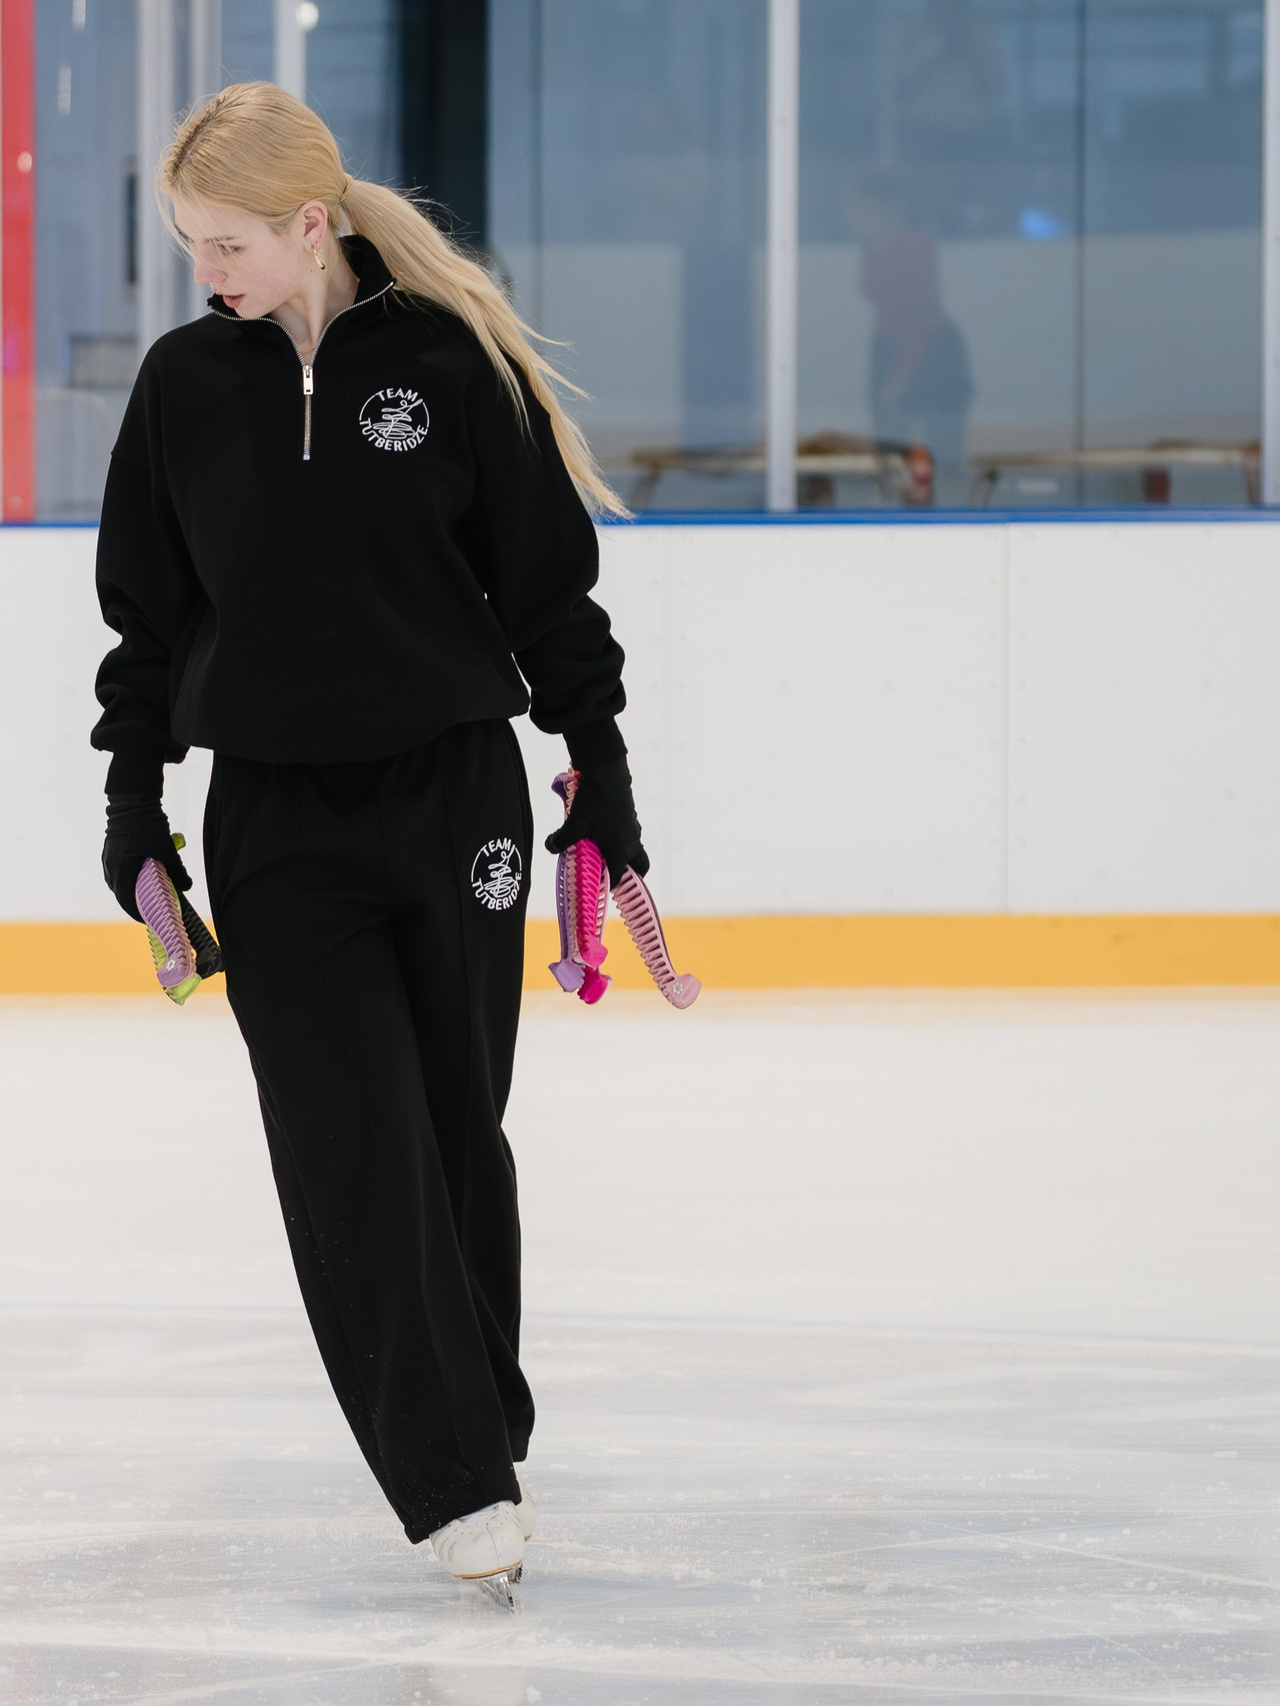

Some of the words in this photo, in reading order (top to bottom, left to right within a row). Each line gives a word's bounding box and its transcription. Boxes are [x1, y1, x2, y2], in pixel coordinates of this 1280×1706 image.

[378, 388, 419, 402] TEAM
[359, 417, 429, 452] TUTBERIDZE
[482, 837, 512, 857] TEAM
